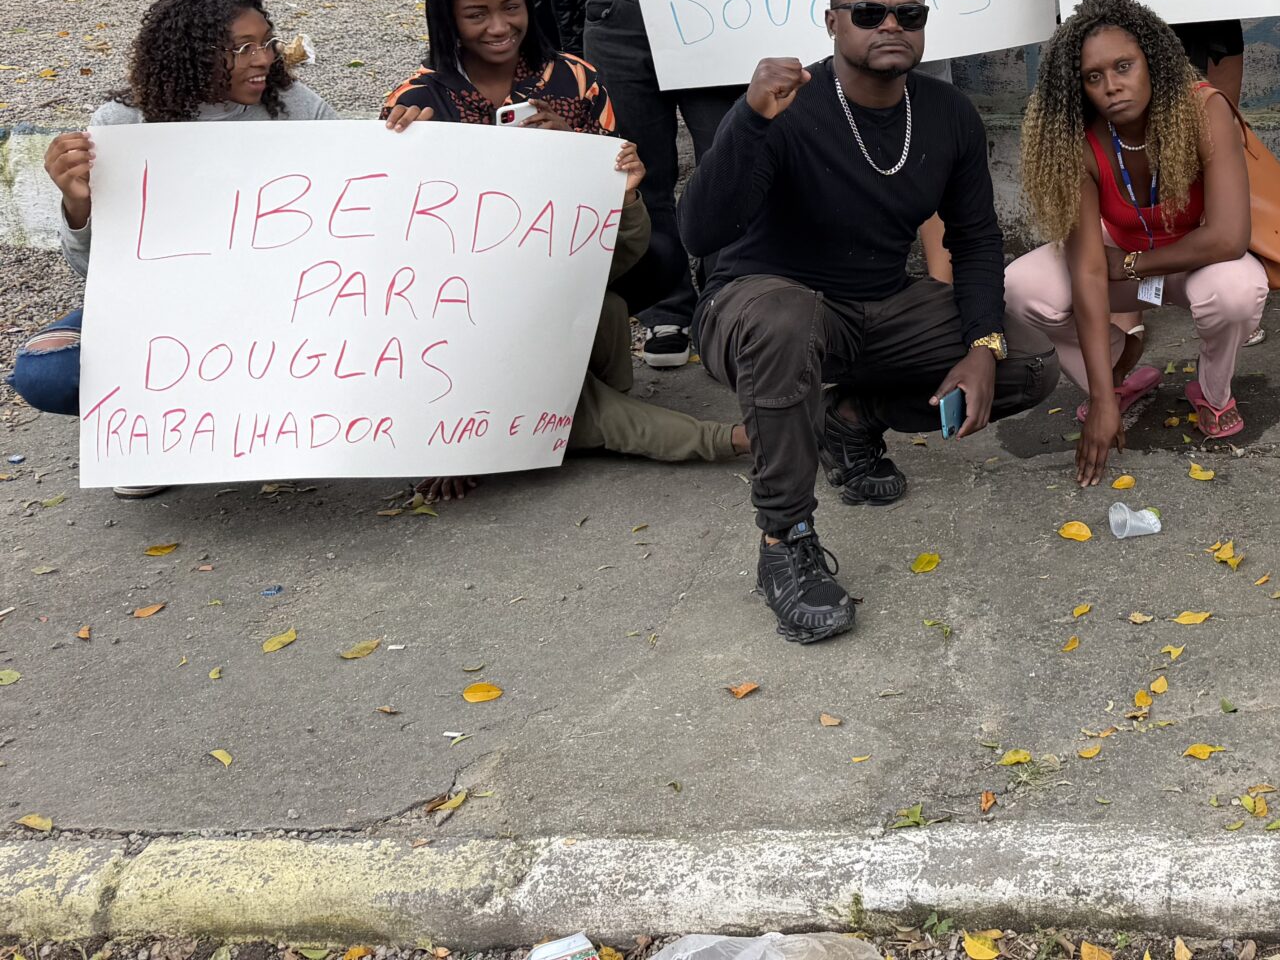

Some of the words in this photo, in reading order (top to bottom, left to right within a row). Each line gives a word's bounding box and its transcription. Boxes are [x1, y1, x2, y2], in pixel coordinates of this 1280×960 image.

[136, 159, 623, 261] LIBERDADE
[291, 260, 476, 326] PARA
[145, 335, 452, 404] DOUGLAS
[83, 385, 397, 463] TRABALHADOR
[428, 409, 489, 446] NÃO
[509, 415, 525, 436] E
